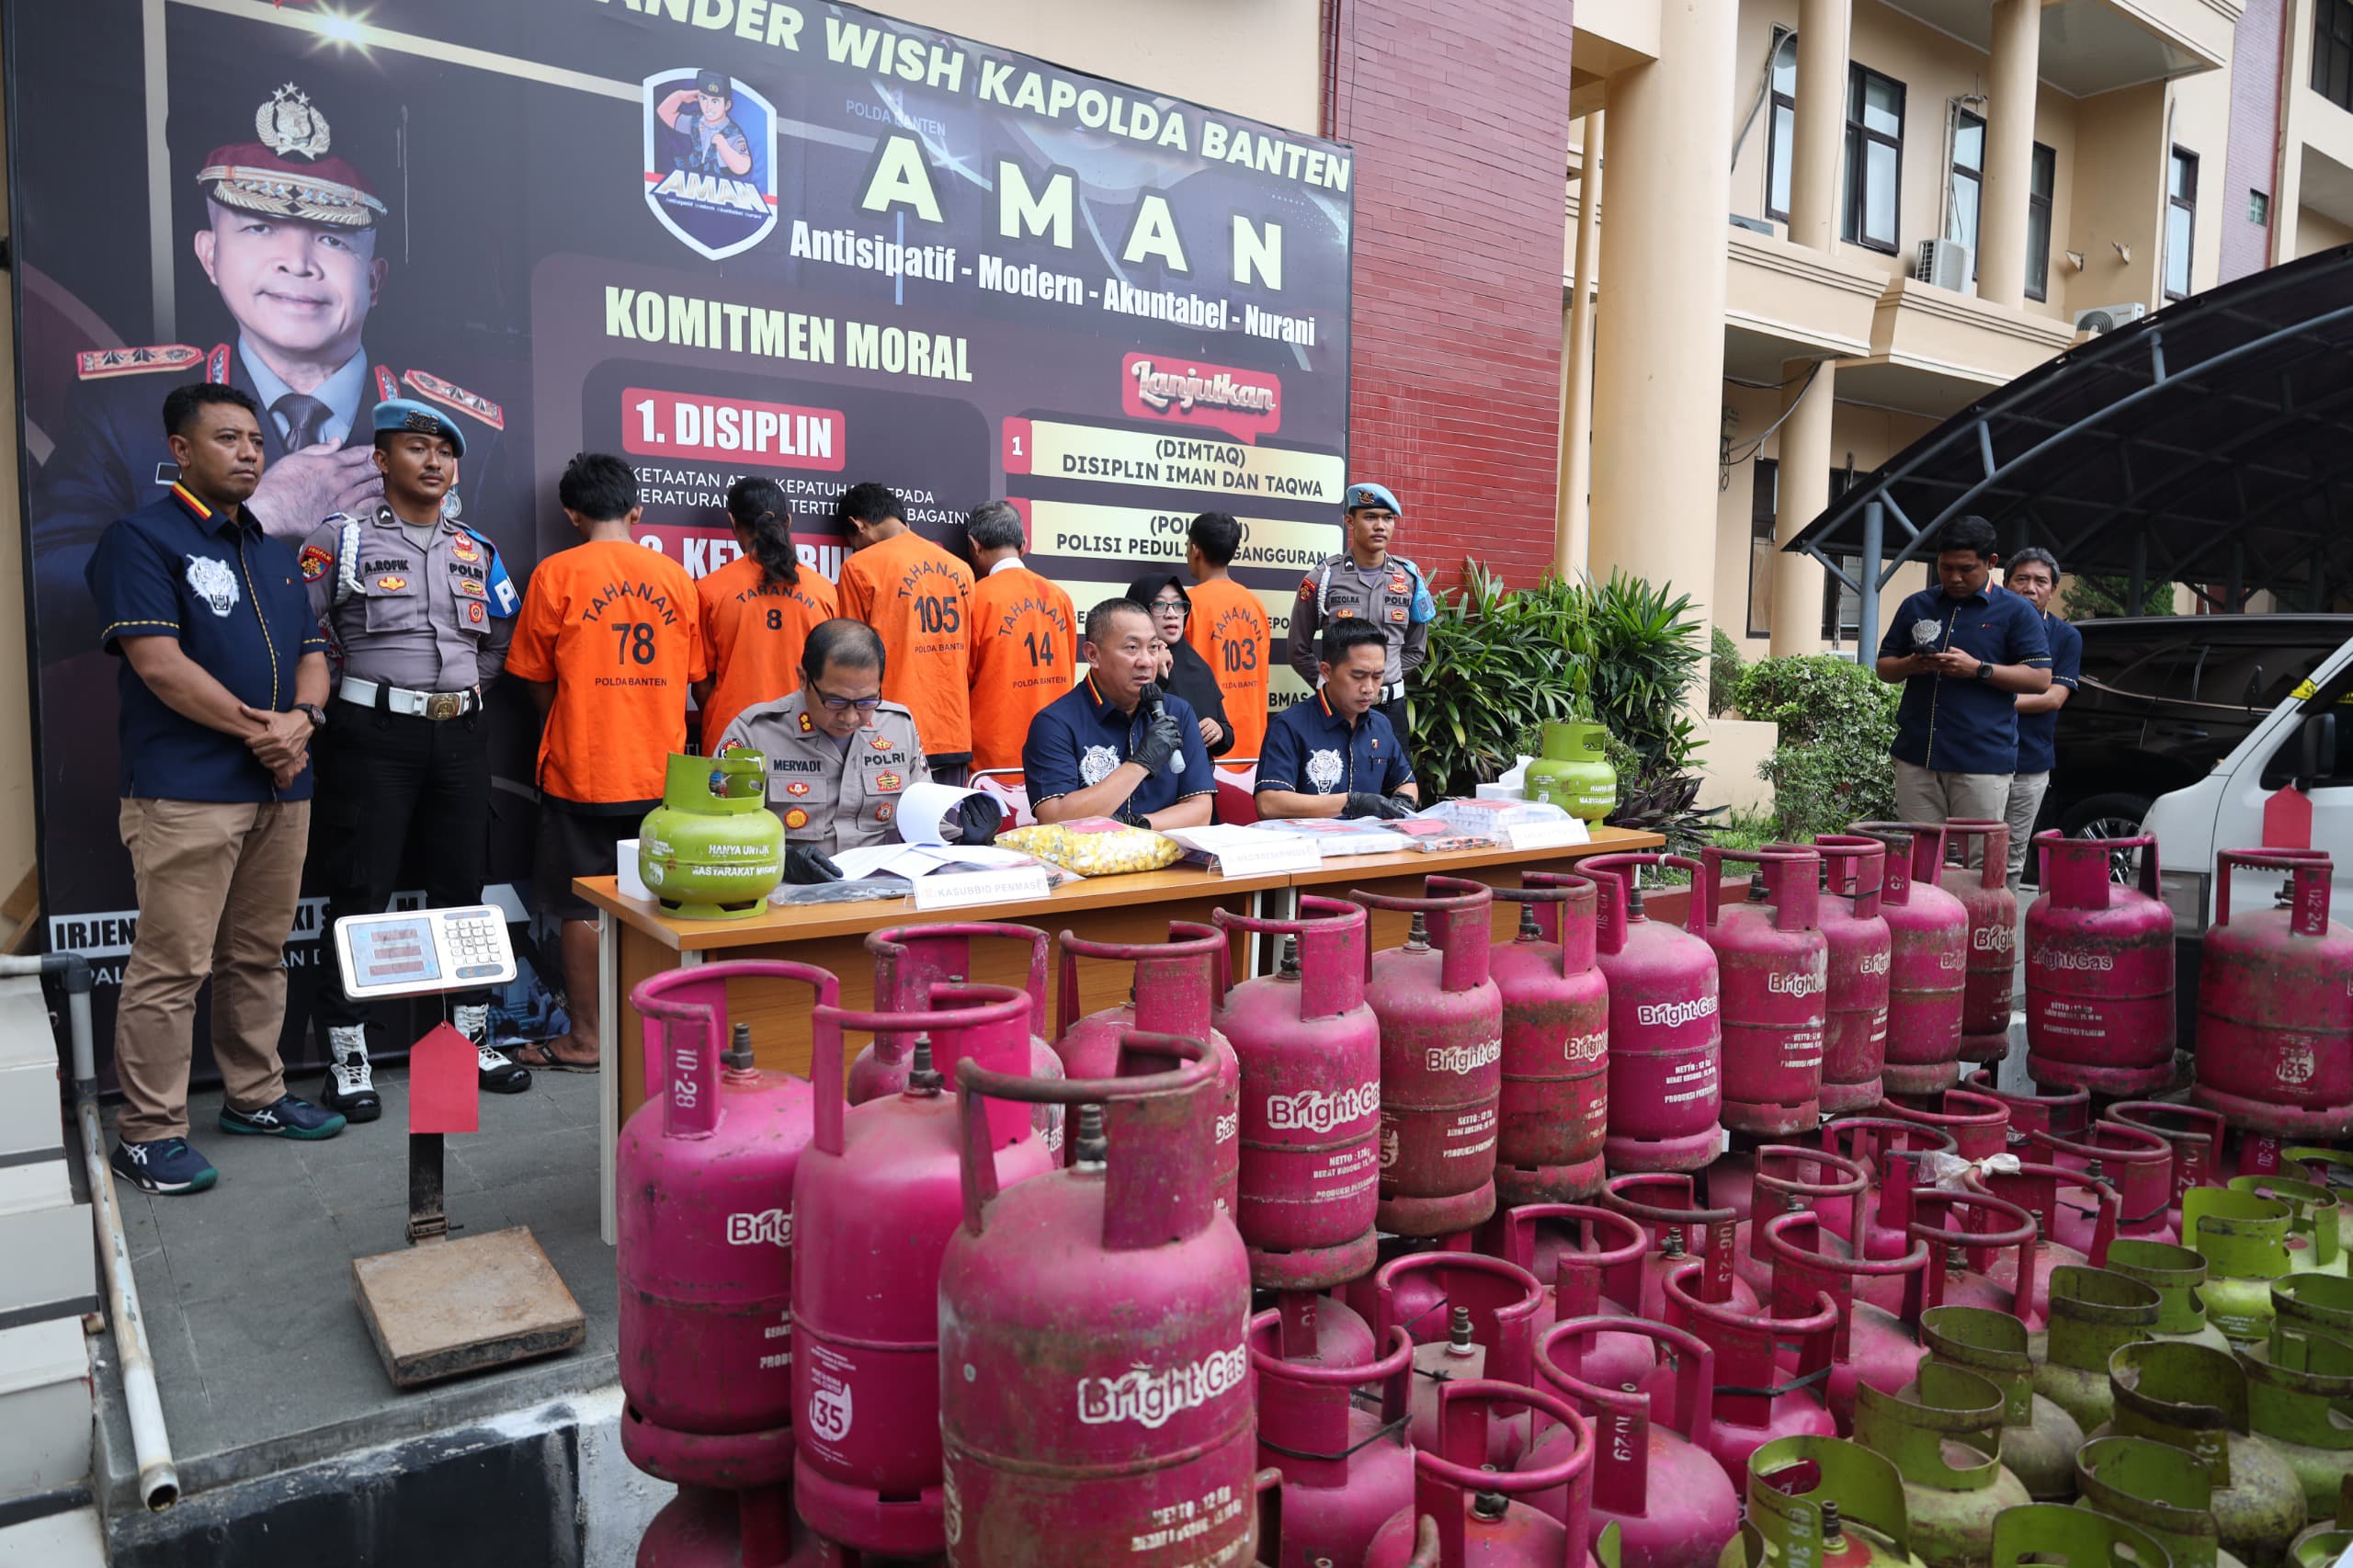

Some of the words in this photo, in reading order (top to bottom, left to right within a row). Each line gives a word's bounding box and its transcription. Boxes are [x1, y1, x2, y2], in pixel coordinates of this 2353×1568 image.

[594, 0, 804, 51] DER
[825, 17, 964, 92] WISH
[979, 61, 1188, 152] KAPOLDA
[1202, 121, 1350, 192] BANTEN
[846, 99, 891, 124] POLDA
[654, 169, 770, 214] AMAN
[790, 220, 956, 283] Antisipatif
[978, 254, 1083, 305] Modern
[1103, 278, 1228, 330] Akuntabel
[1245, 304, 1315, 347] Nurani
[605, 286, 835, 365] KOMITMEN
[847, 321, 972, 382] MORAL
[1131, 360, 1277, 413] Lanjutkan
[635, 399, 665, 443] 1.
[676, 402, 832, 459] DISIPLIN
[1012, 437, 1023, 456] 1
[1155, 439, 1245, 468] (DIMTAQ)
[633, 467, 720, 488] KETAATAN
[776, 478, 855, 496] KEPATUH
[1063, 454, 1159, 482] DISIPLIN
[1166, 465, 1216, 486] IMAN
[1222, 471, 1258, 490] DAN
[1265, 475, 1323, 497] TAQWA
[636, 488, 728, 507] ERATURA
[790, 499, 838, 515] TERTI
[1057, 534, 1121, 553] POLISI
[449, 562, 483, 580] POLRI
[898, 561, 968, 597] TAHANAN
[582, 580, 676, 626] TAHANAN
[736, 585, 814, 609] TAHANAN
[914, 596, 960, 633] 105
[767, 608, 782, 630] 8
[998, 597, 1067, 637] TAHANAN
[1211, 607, 1263, 642] TAHANAN
[611, 622, 655, 665] 78
[1024, 631, 1054, 667] 14
[1222, 638, 1256, 672] 103
[595, 676, 628, 687] POLDA
[629, 677, 667, 687] BANTEN
[773, 759, 821, 772] MERYADI
[864, 753, 905, 767] POLRI
[709, 845, 741, 856] HANYA
[938, 885, 992, 898] KASUBBID
[995, 881, 1036, 892] PENMAS
[56, 917, 137, 950] IRJEN
[676, 1049, 699, 1108] 10-28
[727, 1200, 793, 1247] Brig
